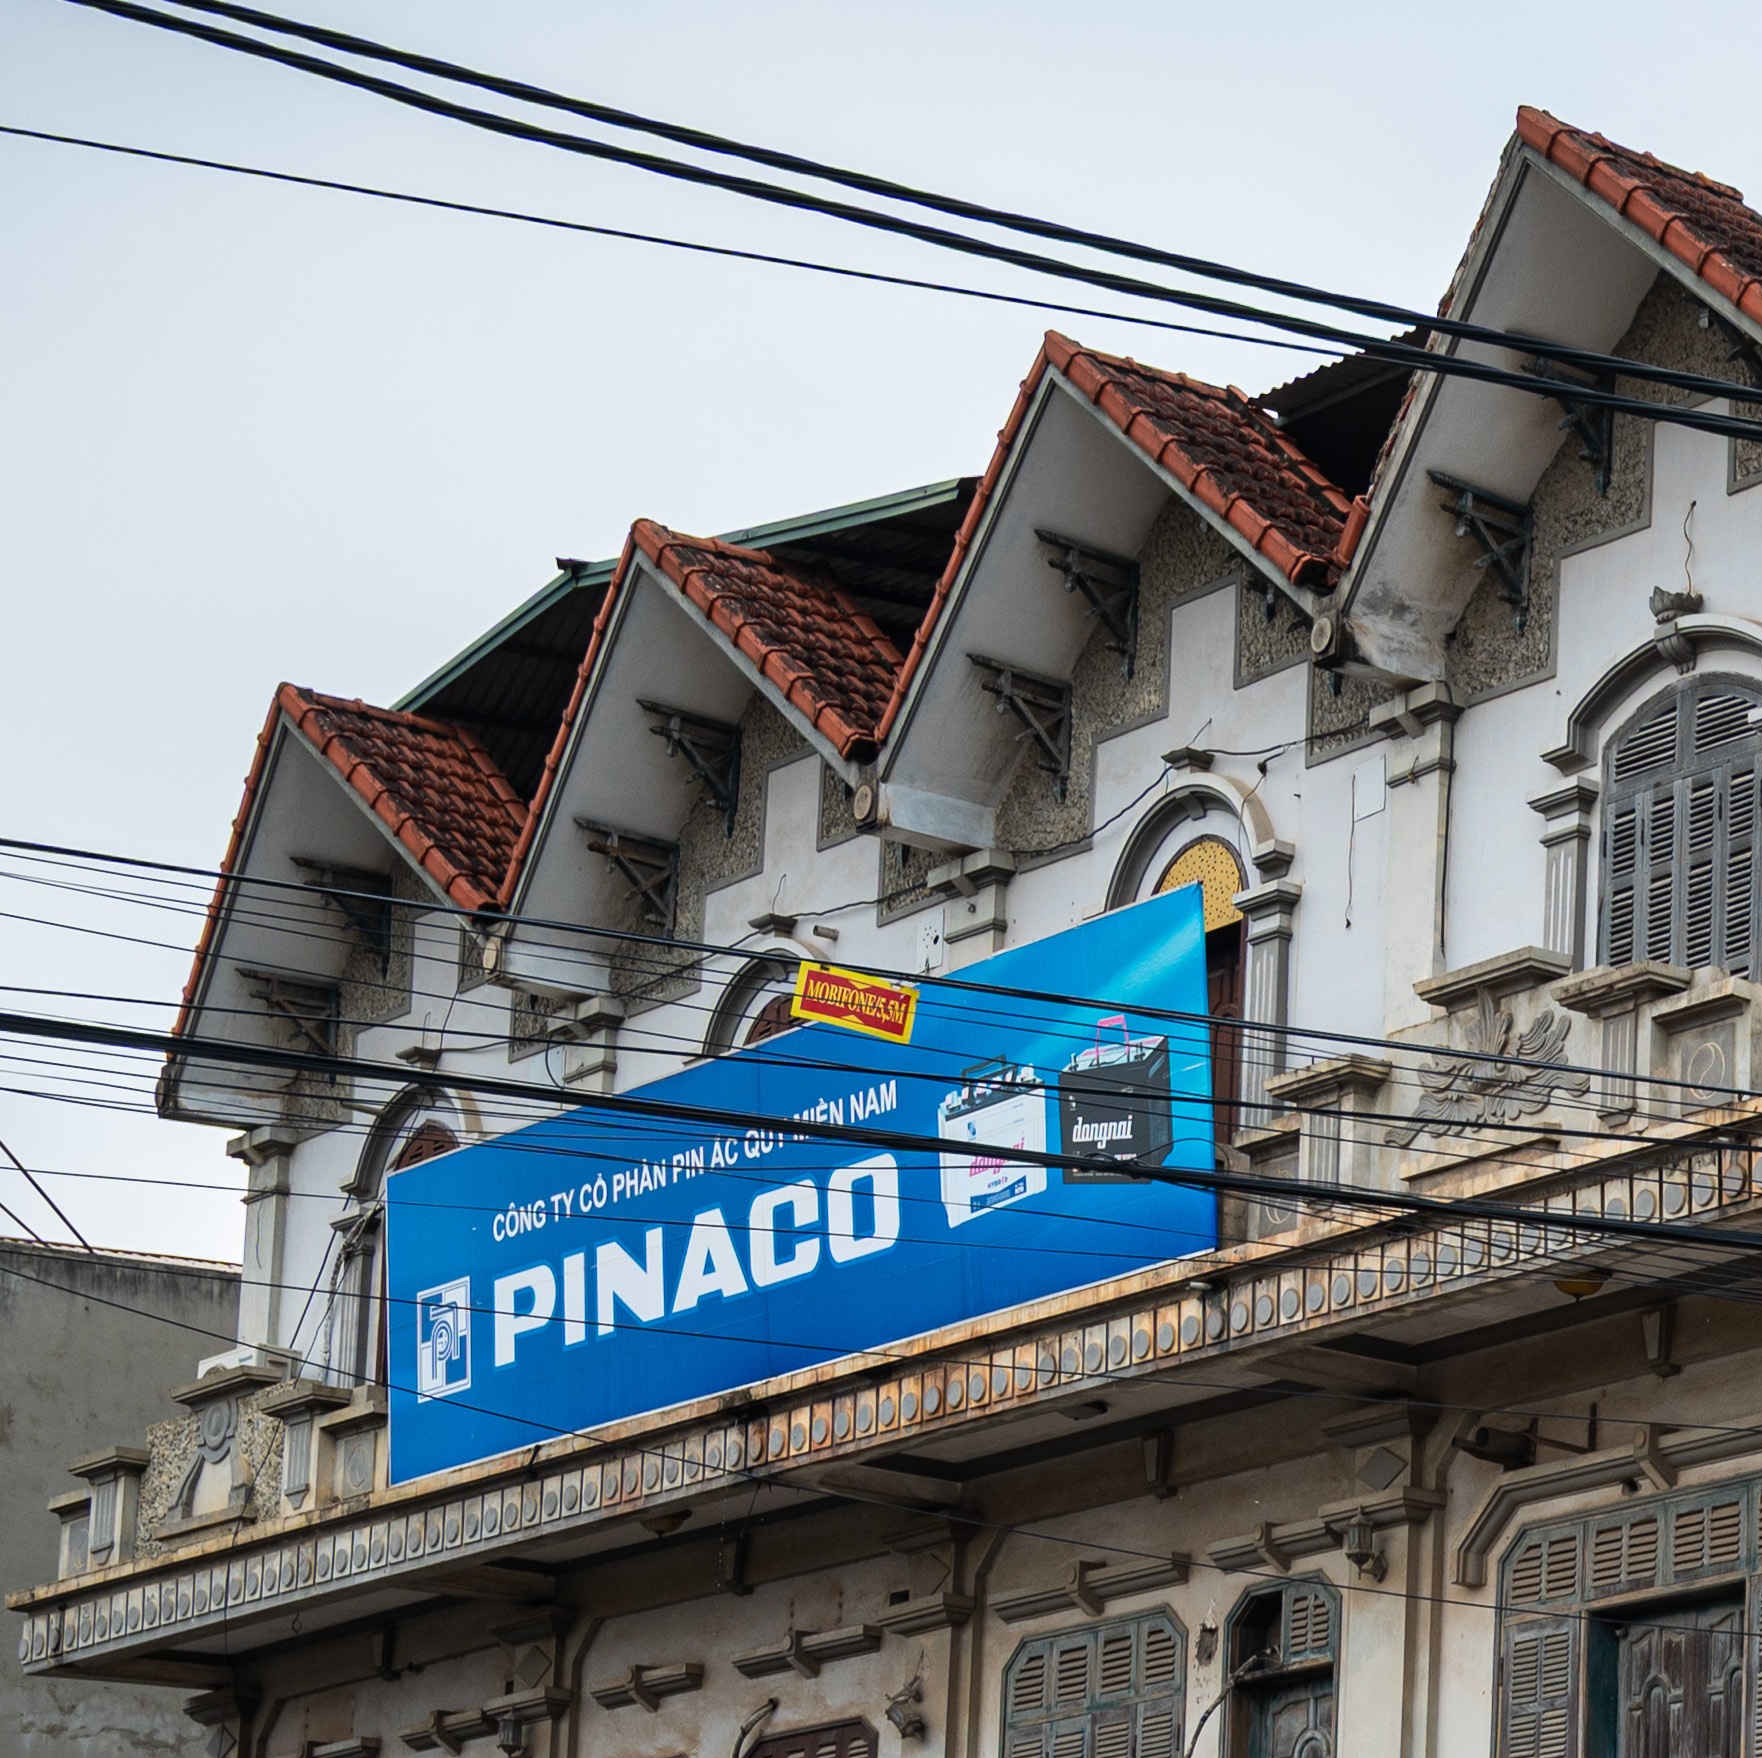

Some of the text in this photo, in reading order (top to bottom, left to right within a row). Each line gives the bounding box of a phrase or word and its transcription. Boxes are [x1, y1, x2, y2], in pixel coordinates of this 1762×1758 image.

[493, 1203, 546, 1242] CÔNG
[550, 1189, 576, 1222] TY
[672, 1146, 704, 1184] PIN
[850, 1079, 897, 1124] NAM
[1072, 1114, 1133, 1150] dongnai
[493, 1152, 901, 1368] PINACO
